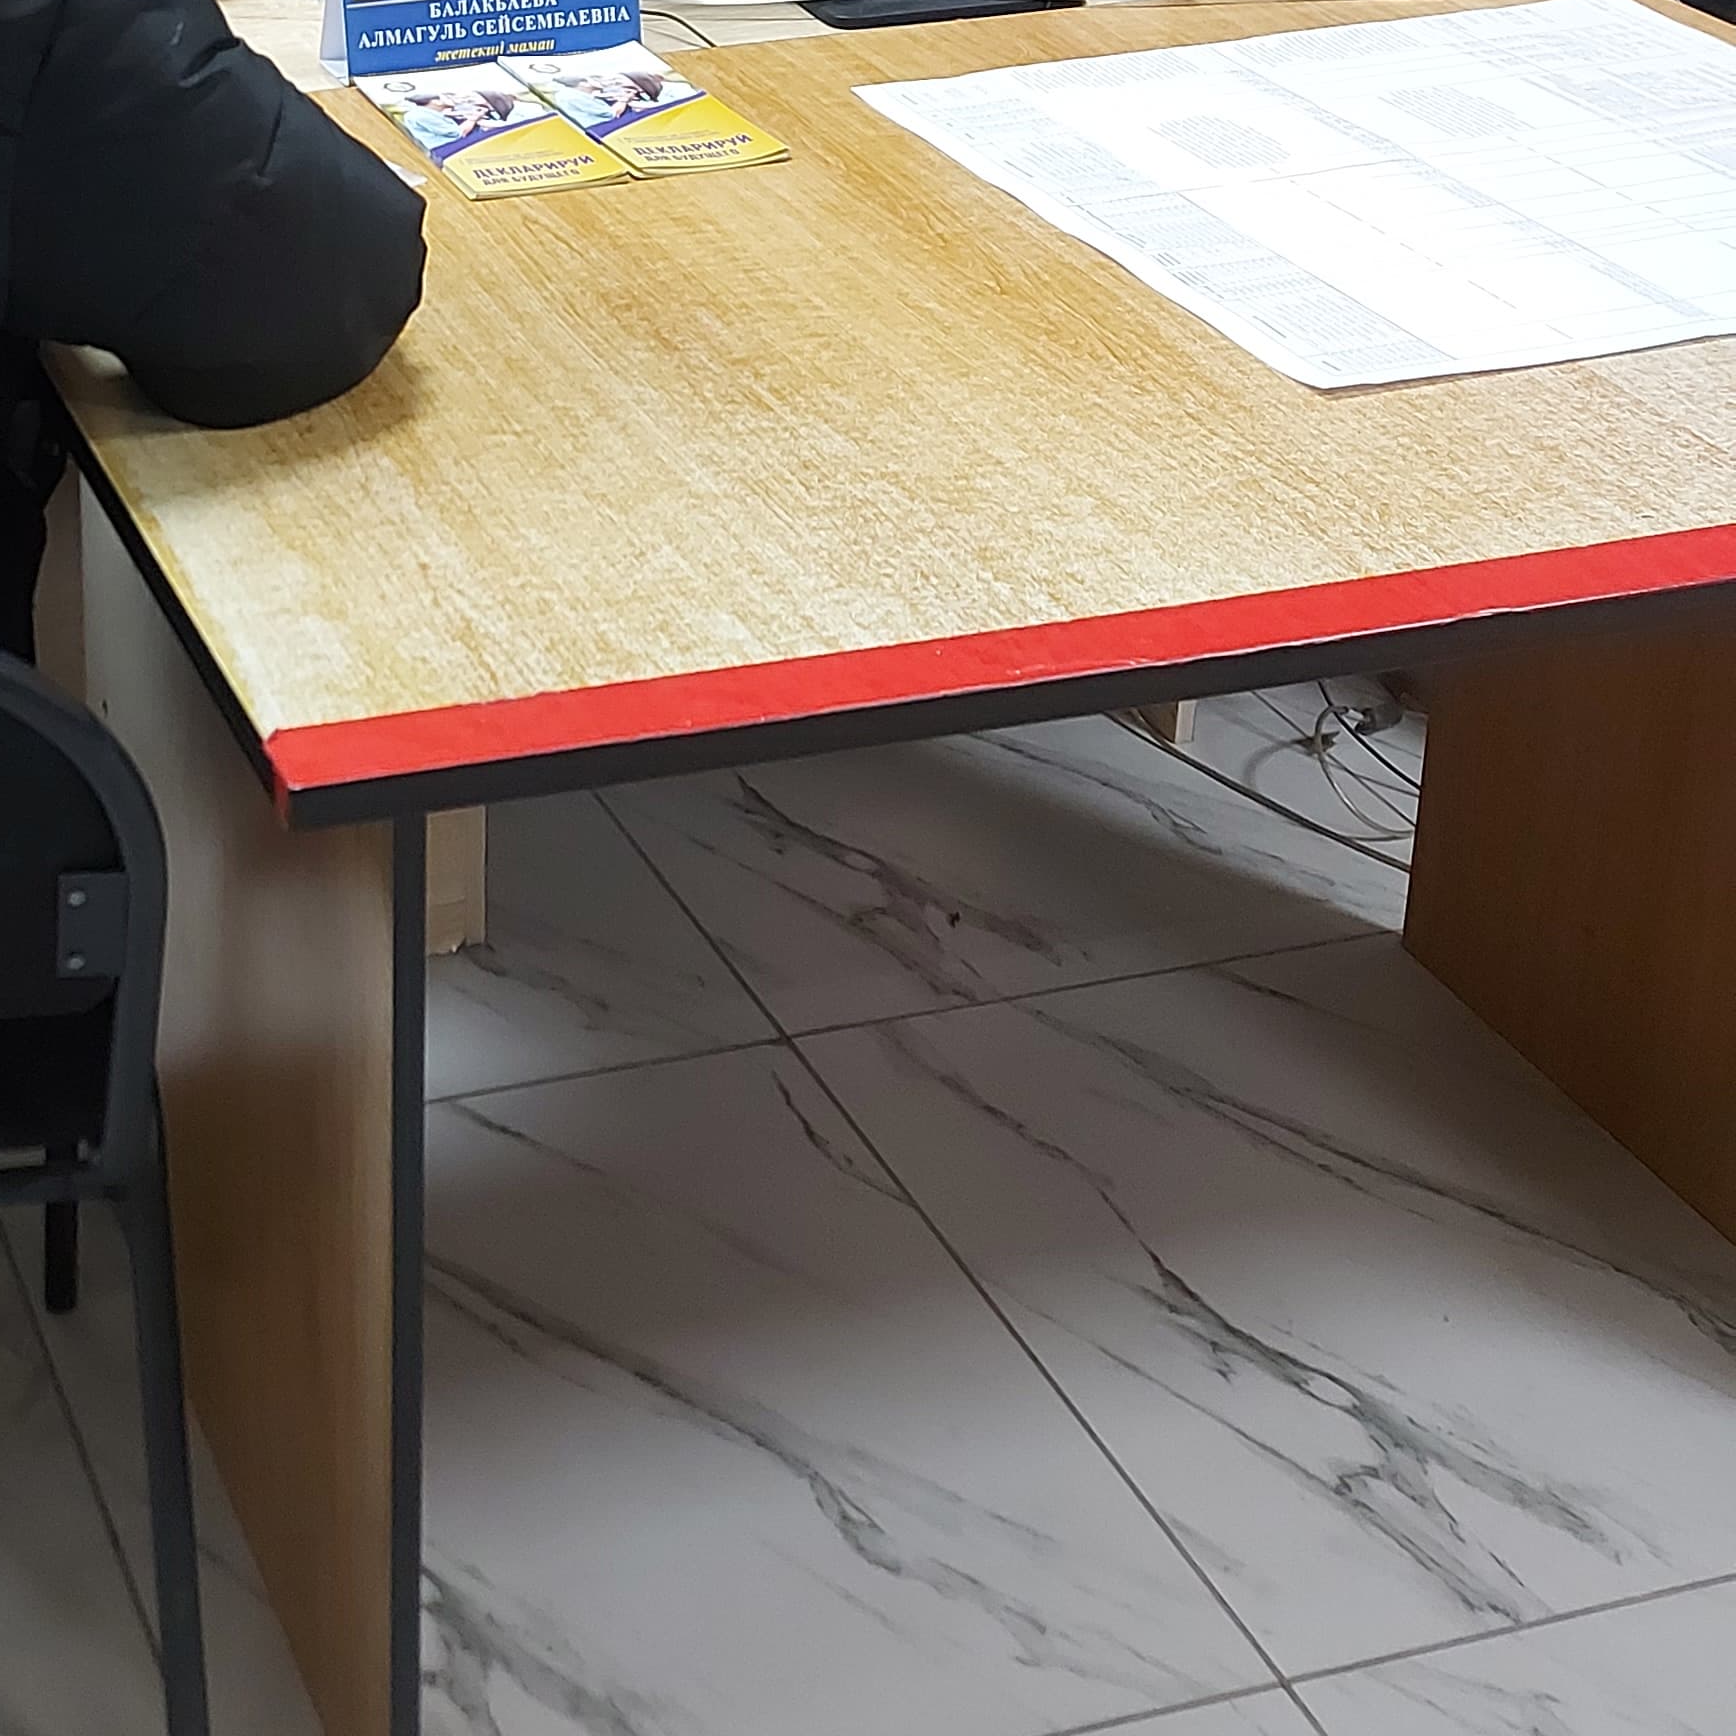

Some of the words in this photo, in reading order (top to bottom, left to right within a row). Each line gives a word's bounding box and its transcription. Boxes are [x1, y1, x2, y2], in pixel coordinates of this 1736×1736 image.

[358, 22, 467, 49] АЛМАГУЛЬ
[471, 6, 631, 36] СЕЙСЕМБАЕВНА
[506, 39, 555, 55] маман
